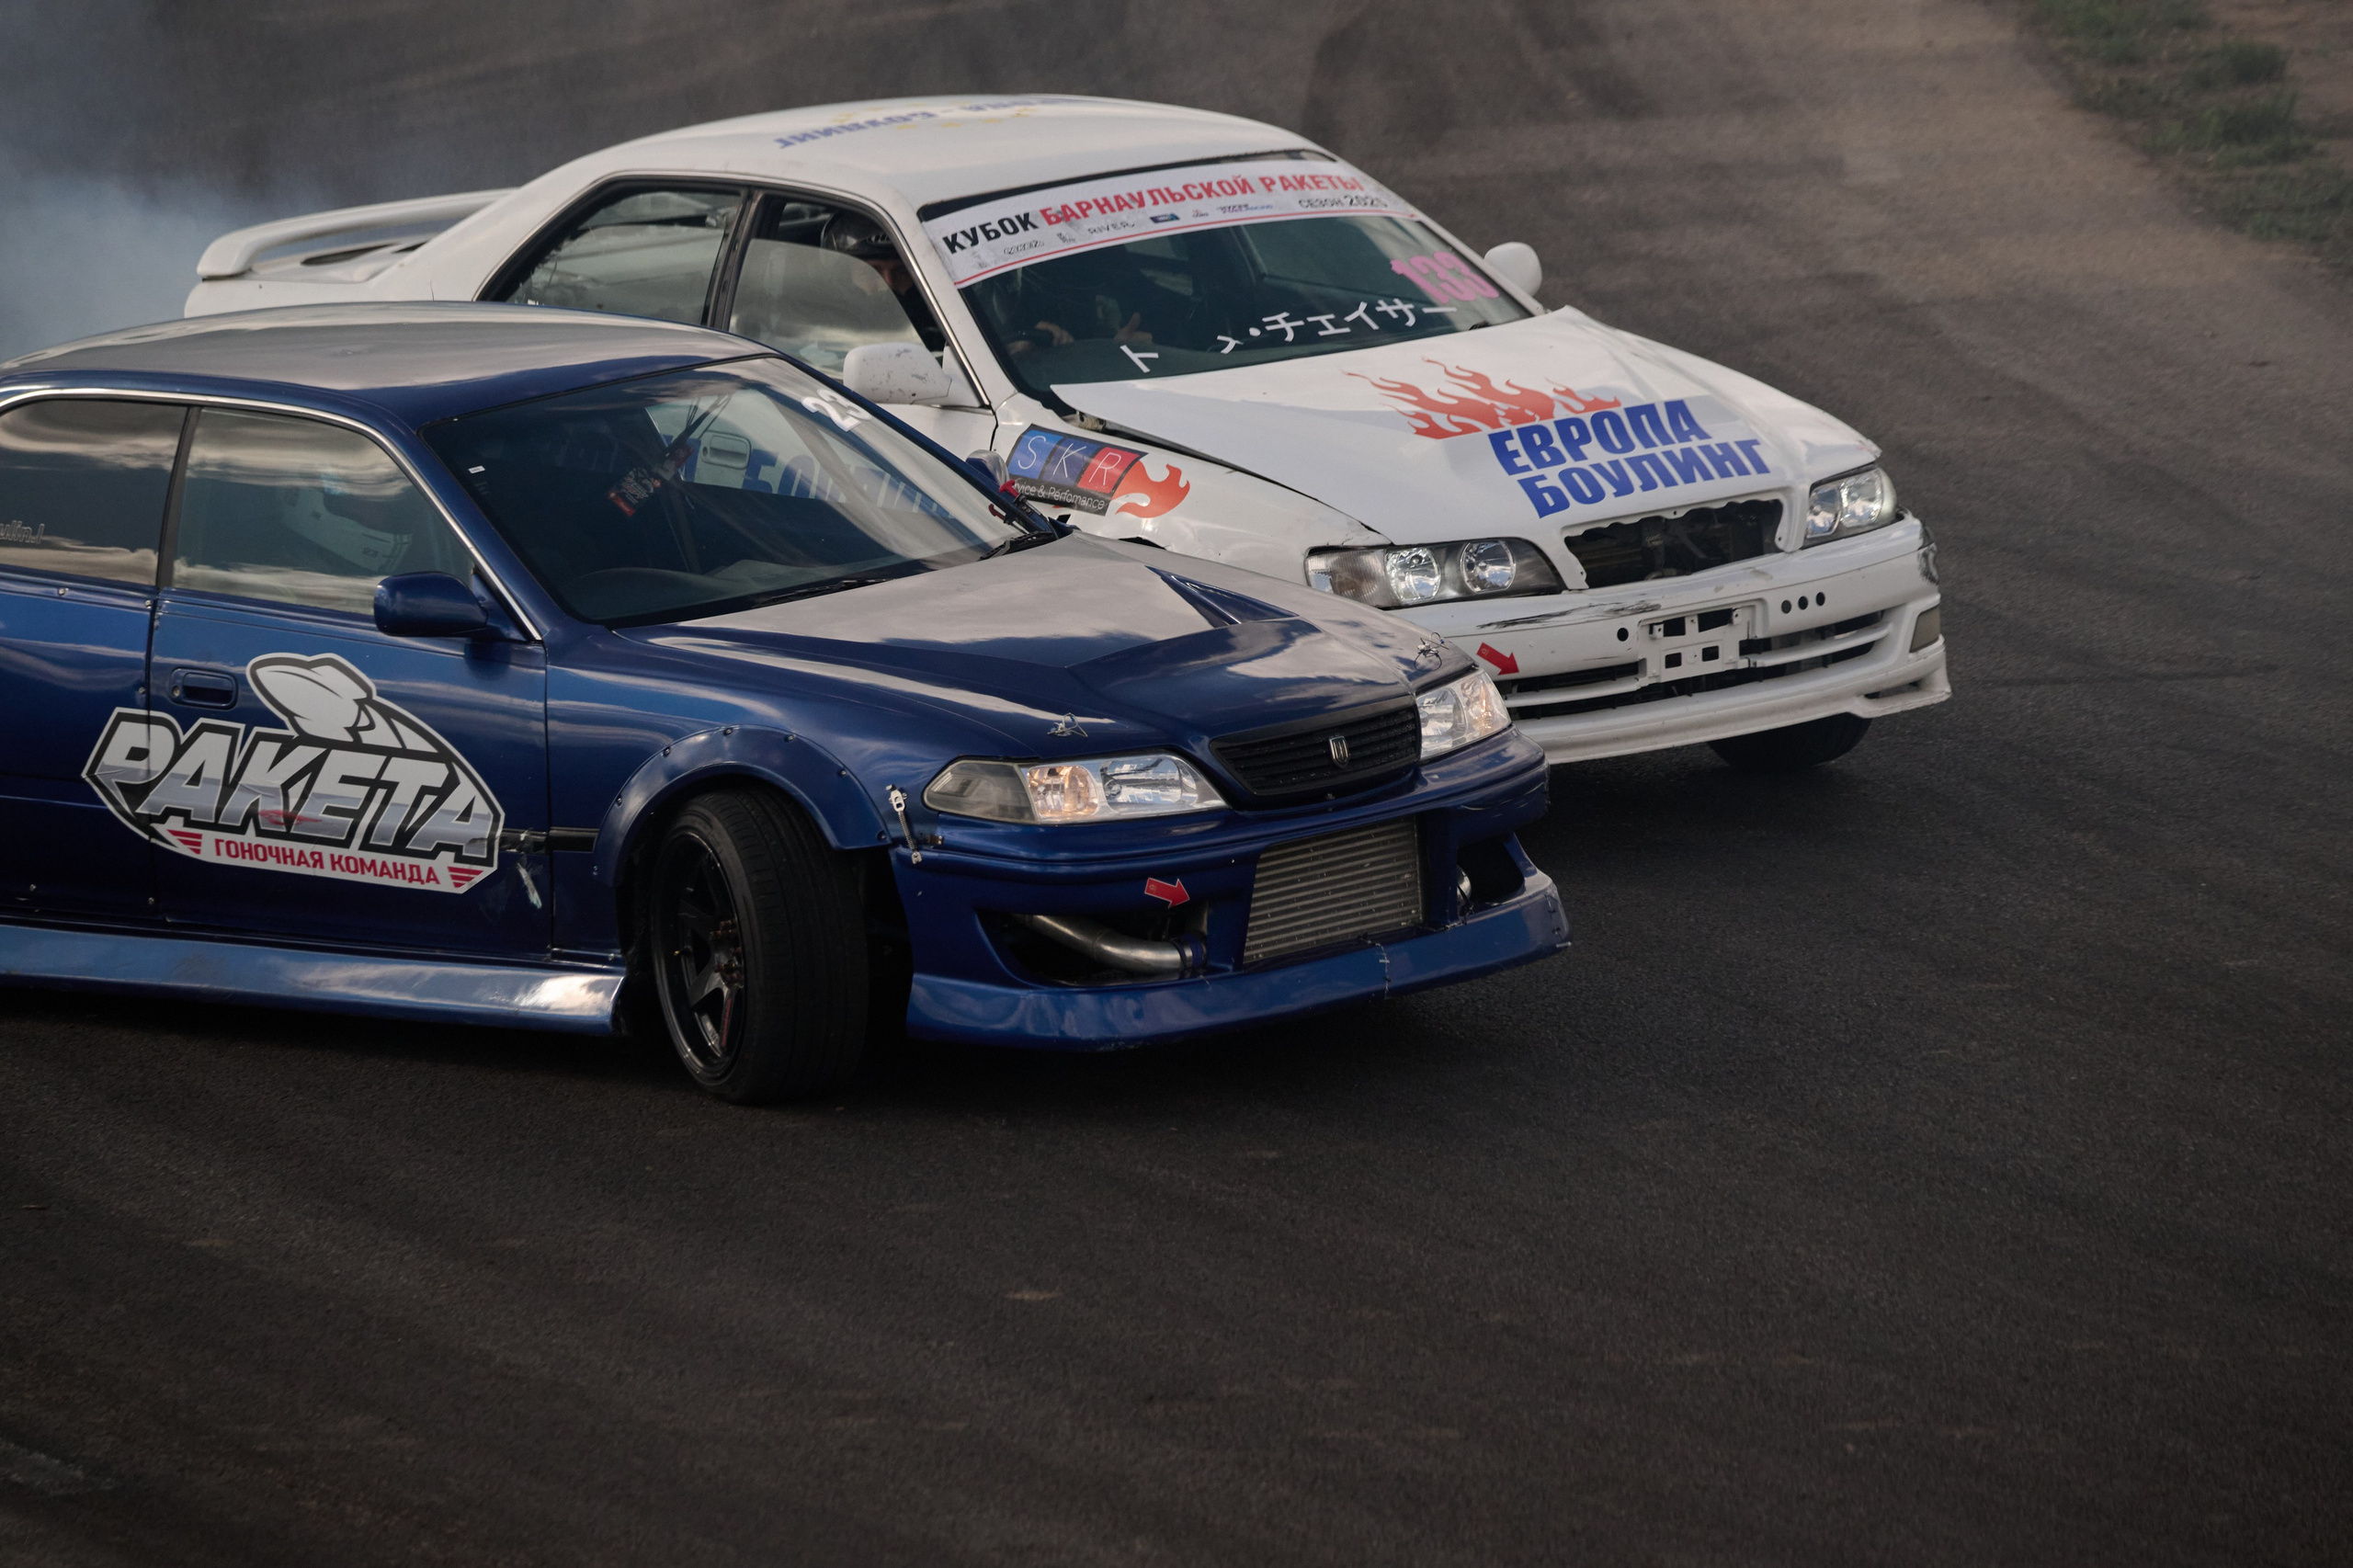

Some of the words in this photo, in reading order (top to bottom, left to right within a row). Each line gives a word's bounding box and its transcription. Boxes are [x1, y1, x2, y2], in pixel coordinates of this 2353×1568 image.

[941, 211, 1040, 255] КУБОК
[1039, 175, 1256, 227] БАРНАУЛЬСКОЙ
[1264, 173, 1366, 194] РАКЕТЫ
[1391, 250, 1500, 304] 133
[801, 388, 872, 433] 23
[1017, 435, 1122, 486] SKR
[1487, 399, 1711, 477] ЕВРОПА
[1014, 482, 1036, 496] rvice
[1037, 484, 1046, 498] &
[1048, 486, 1105, 510] Perfomance
[1517, 437, 1771, 519] БОУЛИНГ
[98, 717, 494, 858] РАКЕТА
[214, 837, 324, 872] ГОНОЧНАЯ
[329, 853, 440, 887] КОМАНДА
